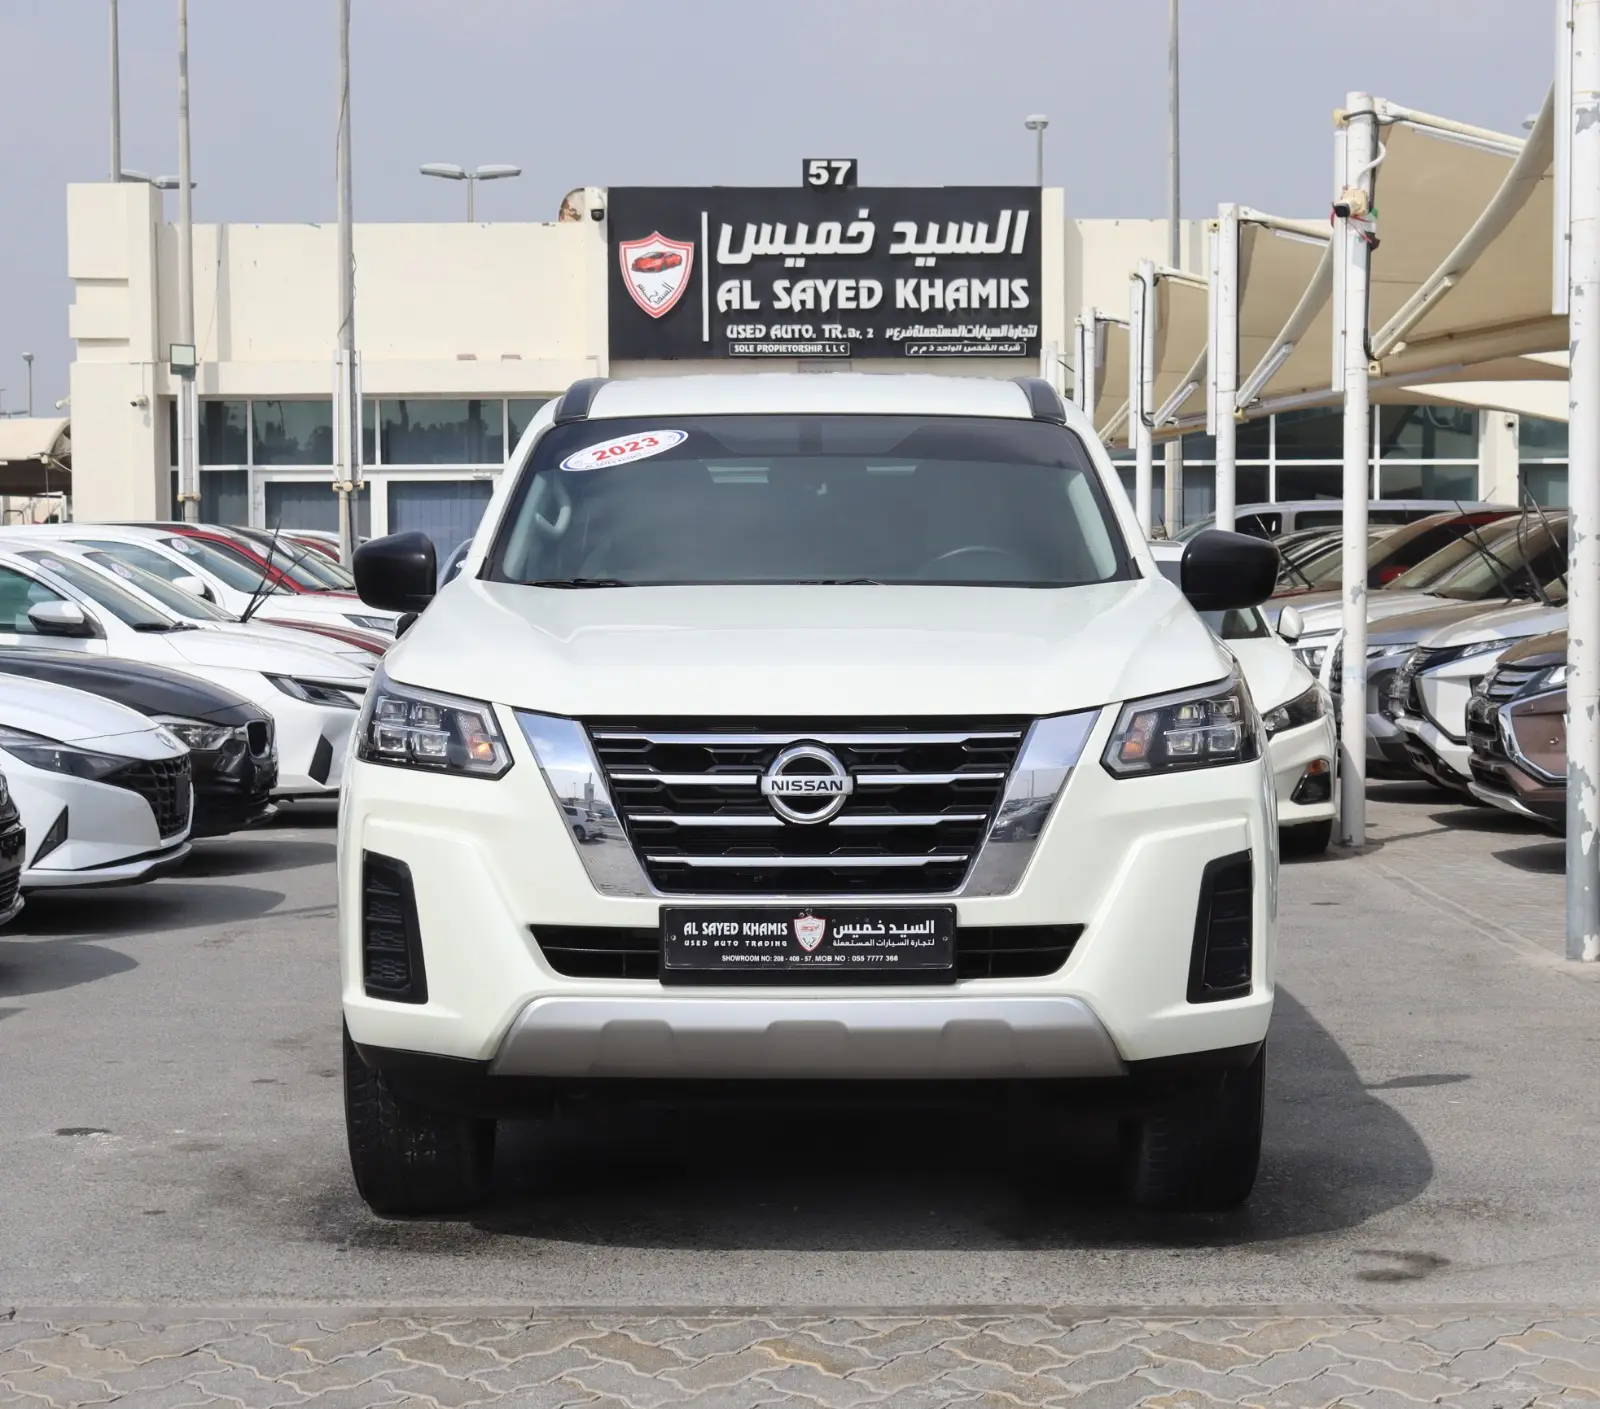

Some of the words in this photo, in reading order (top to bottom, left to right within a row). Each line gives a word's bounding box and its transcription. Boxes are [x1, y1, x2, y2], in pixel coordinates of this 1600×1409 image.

[808, 160, 852, 185] 57
[716, 208, 876, 268] خميس
[889, 209, 1030, 267] السيد
[717, 278, 761, 313] AL
[773, 278, 883, 313] SAYED
[896, 278, 1030, 313] KHAMIS
[726, 324, 766, 339] USED
[770, 324, 817, 340] AUTO.
[866, 328, 874, 338] 2
[734, 345, 754, 353] SOLE
[592, 437, 660, 461] 2023
[771, 780, 843, 791] NISSAN
[683, 922, 699, 936] AL
[702, 922, 739, 936] SAYED
[742, 922, 788, 936] KHAMIS
[832, 920, 885, 938] خميس
[889, 920, 935, 938] السيد
[876, 939, 910, 948] السيارات
[910, 939, 935, 948] لتجارة
